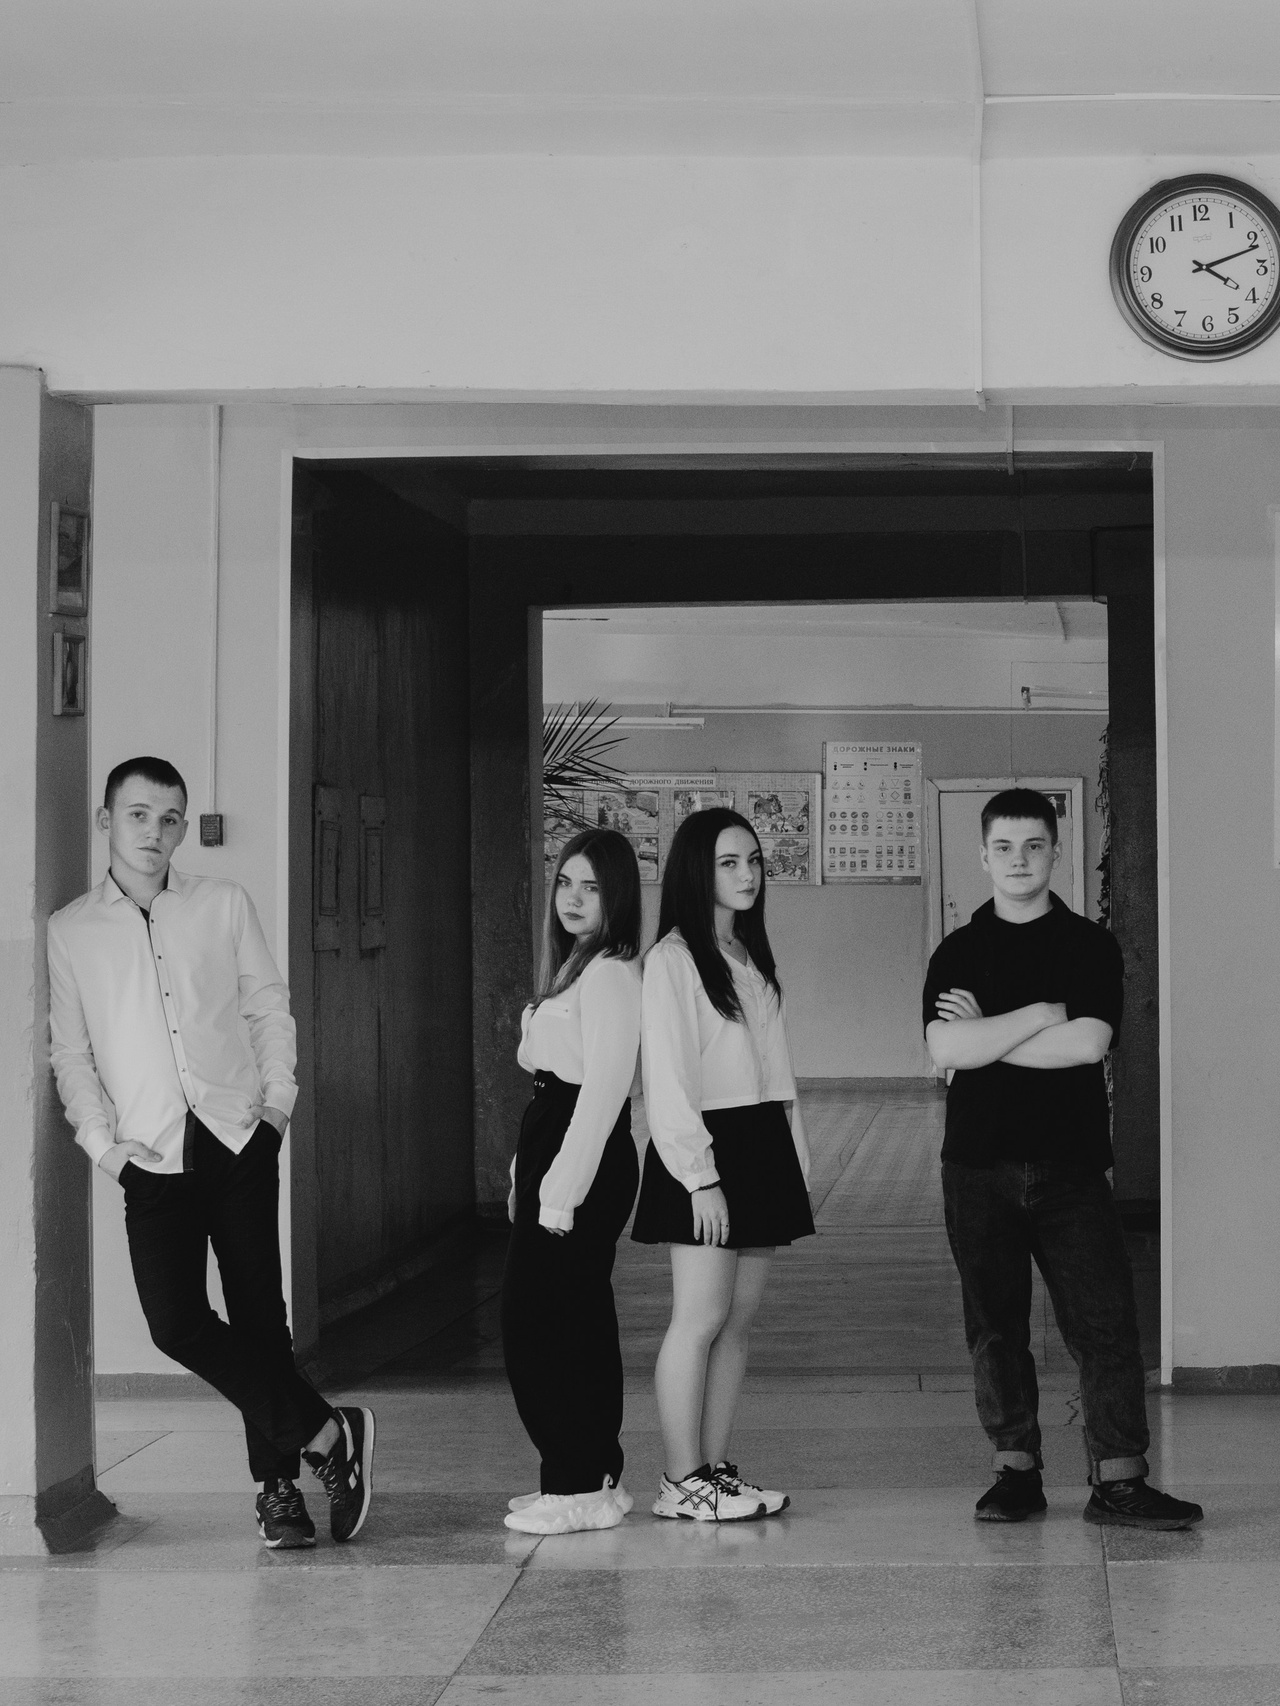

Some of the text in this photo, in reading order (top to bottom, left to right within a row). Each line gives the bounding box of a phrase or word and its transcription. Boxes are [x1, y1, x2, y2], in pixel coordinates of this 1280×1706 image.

[1192, 203, 1210, 221] 12
[1228, 211, 1234, 228] 1
[1170, 214, 1183, 232] 11
[1149, 236, 1166, 253] 10
[1246, 230, 1260, 249] 2
[1139, 265, 1152, 282] 9
[1255, 258, 1268, 275] 3
[1150, 292, 1163, 309] 8
[1244, 287, 1259, 303] 4
[1173, 309, 1187, 327] 7
[1201, 315, 1214, 332] 6
[1227, 306, 1240, 324] 5
[629, 778, 672, 787] дорожного
[674, 778, 714, 786] движения
